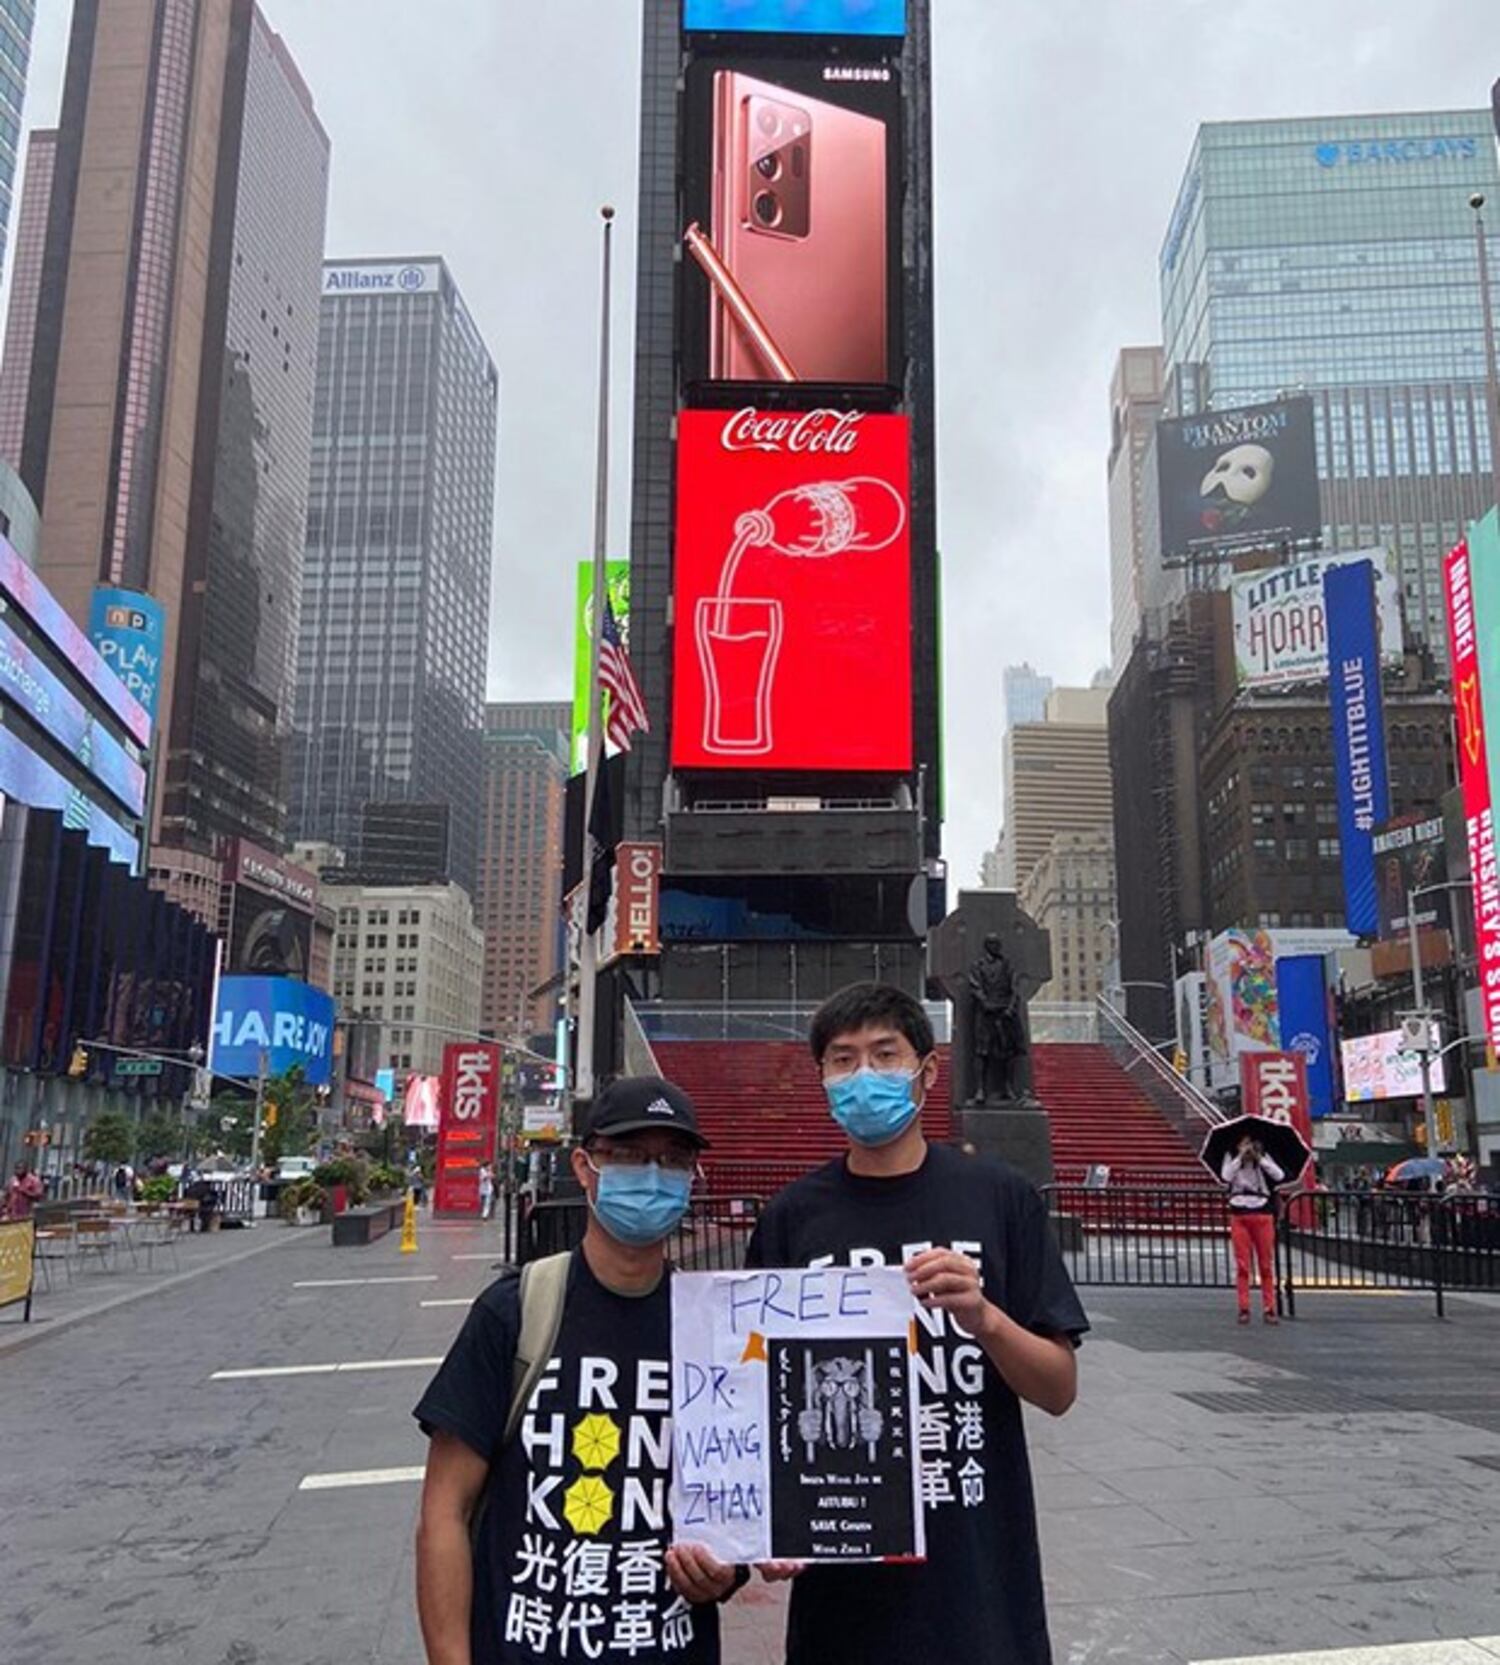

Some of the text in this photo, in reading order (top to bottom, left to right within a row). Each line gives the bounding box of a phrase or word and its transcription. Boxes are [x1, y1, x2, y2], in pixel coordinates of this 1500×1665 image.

[823, 67, 890, 81] SAMSUNG
[1347, 138, 1477, 163] BARCLAYS
[326, 271, 394, 289] Allianz
[721, 406, 866, 452] Coca-Cola
[1183, 412, 1287, 442] PHANTOM
[1248, 563, 1321, 610] LITTLE
[1342, 656, 1375, 831] #LIGHTITBLUE
[629, 849, 654, 948] HELLO!
[1480, 808, 1499, 960] HERSHEY'S
[455, 1051, 491, 1120] tkts
[728, 1272, 872, 1334] FREE
[527, 1356, 670, 1411] FRE
[679, 1362, 735, 1410] DR.
[684, 1479, 762, 1525] ZHAN
[512, 1533, 673, 1597] 光復香
[504, 1592, 695, 1660] 時代革命
